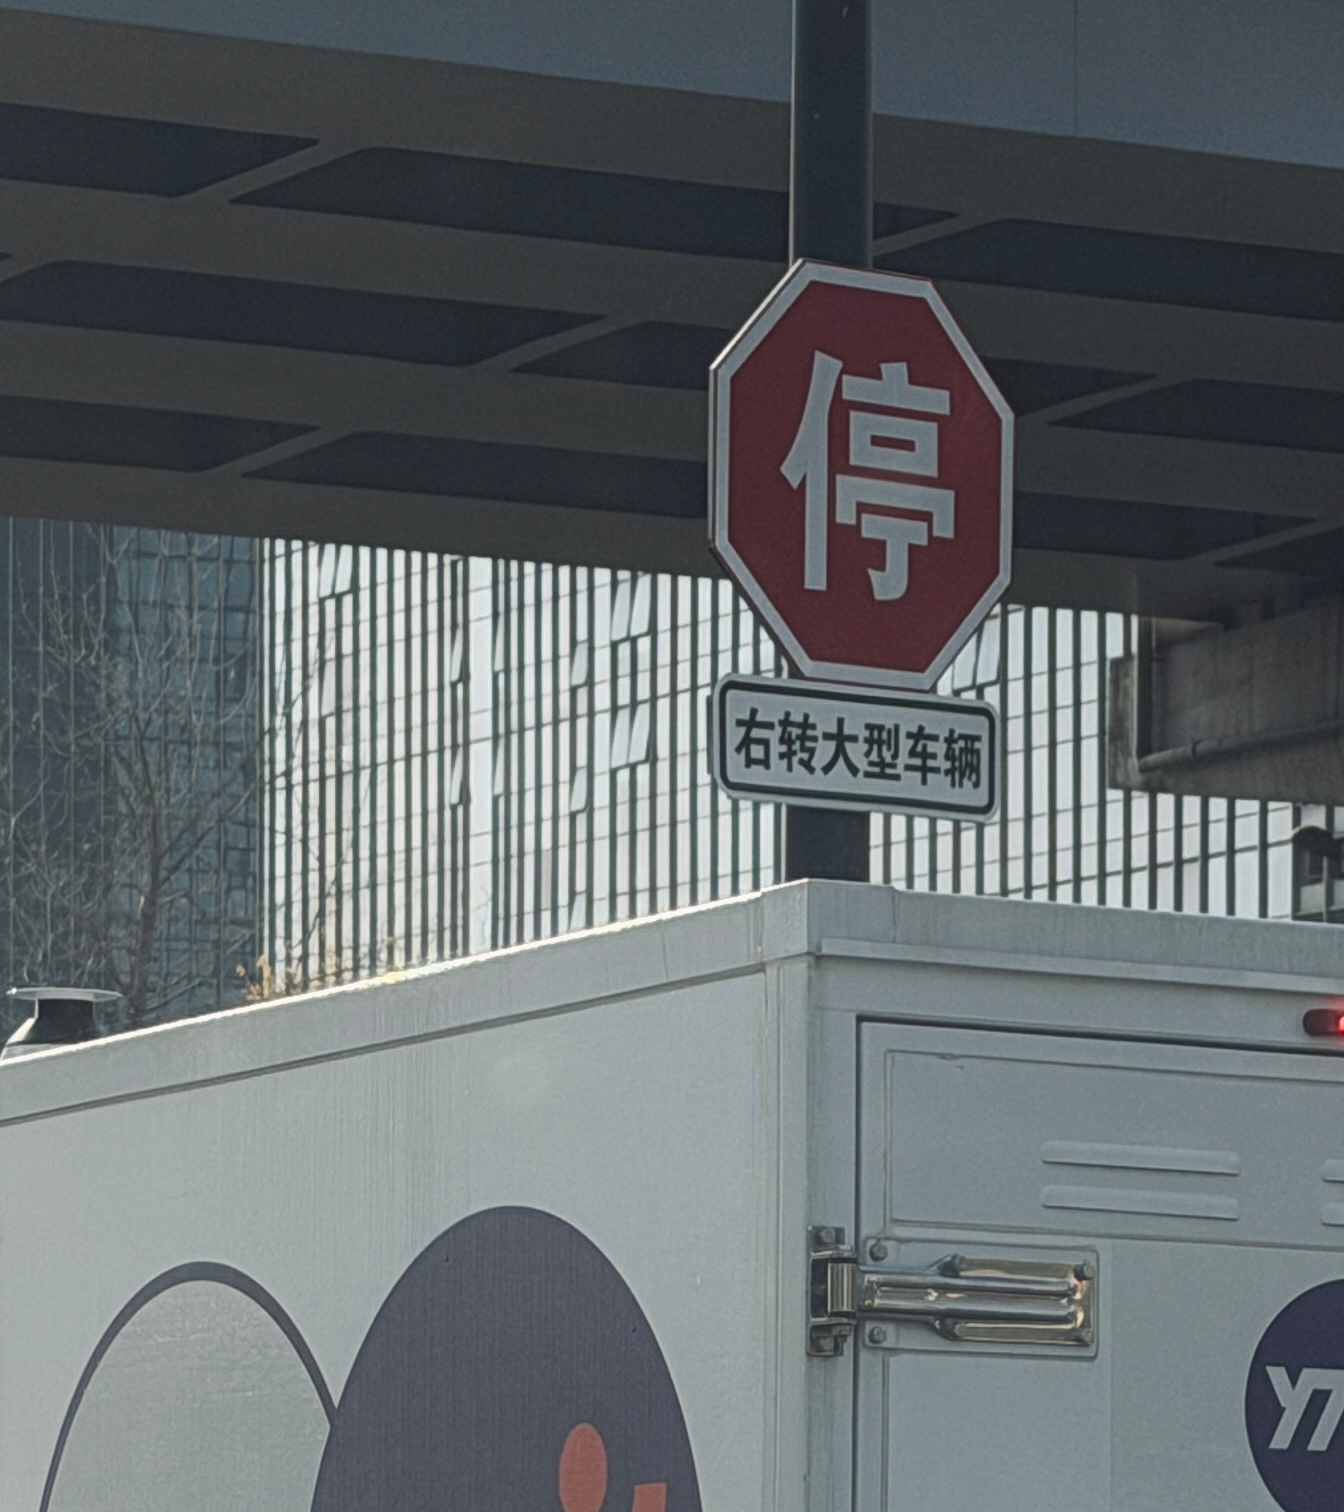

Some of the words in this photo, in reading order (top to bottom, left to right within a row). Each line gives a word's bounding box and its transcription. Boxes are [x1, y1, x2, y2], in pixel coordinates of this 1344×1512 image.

[779, 349, 955, 601] 停
[734, 706, 982, 790] 右转大型车辆
